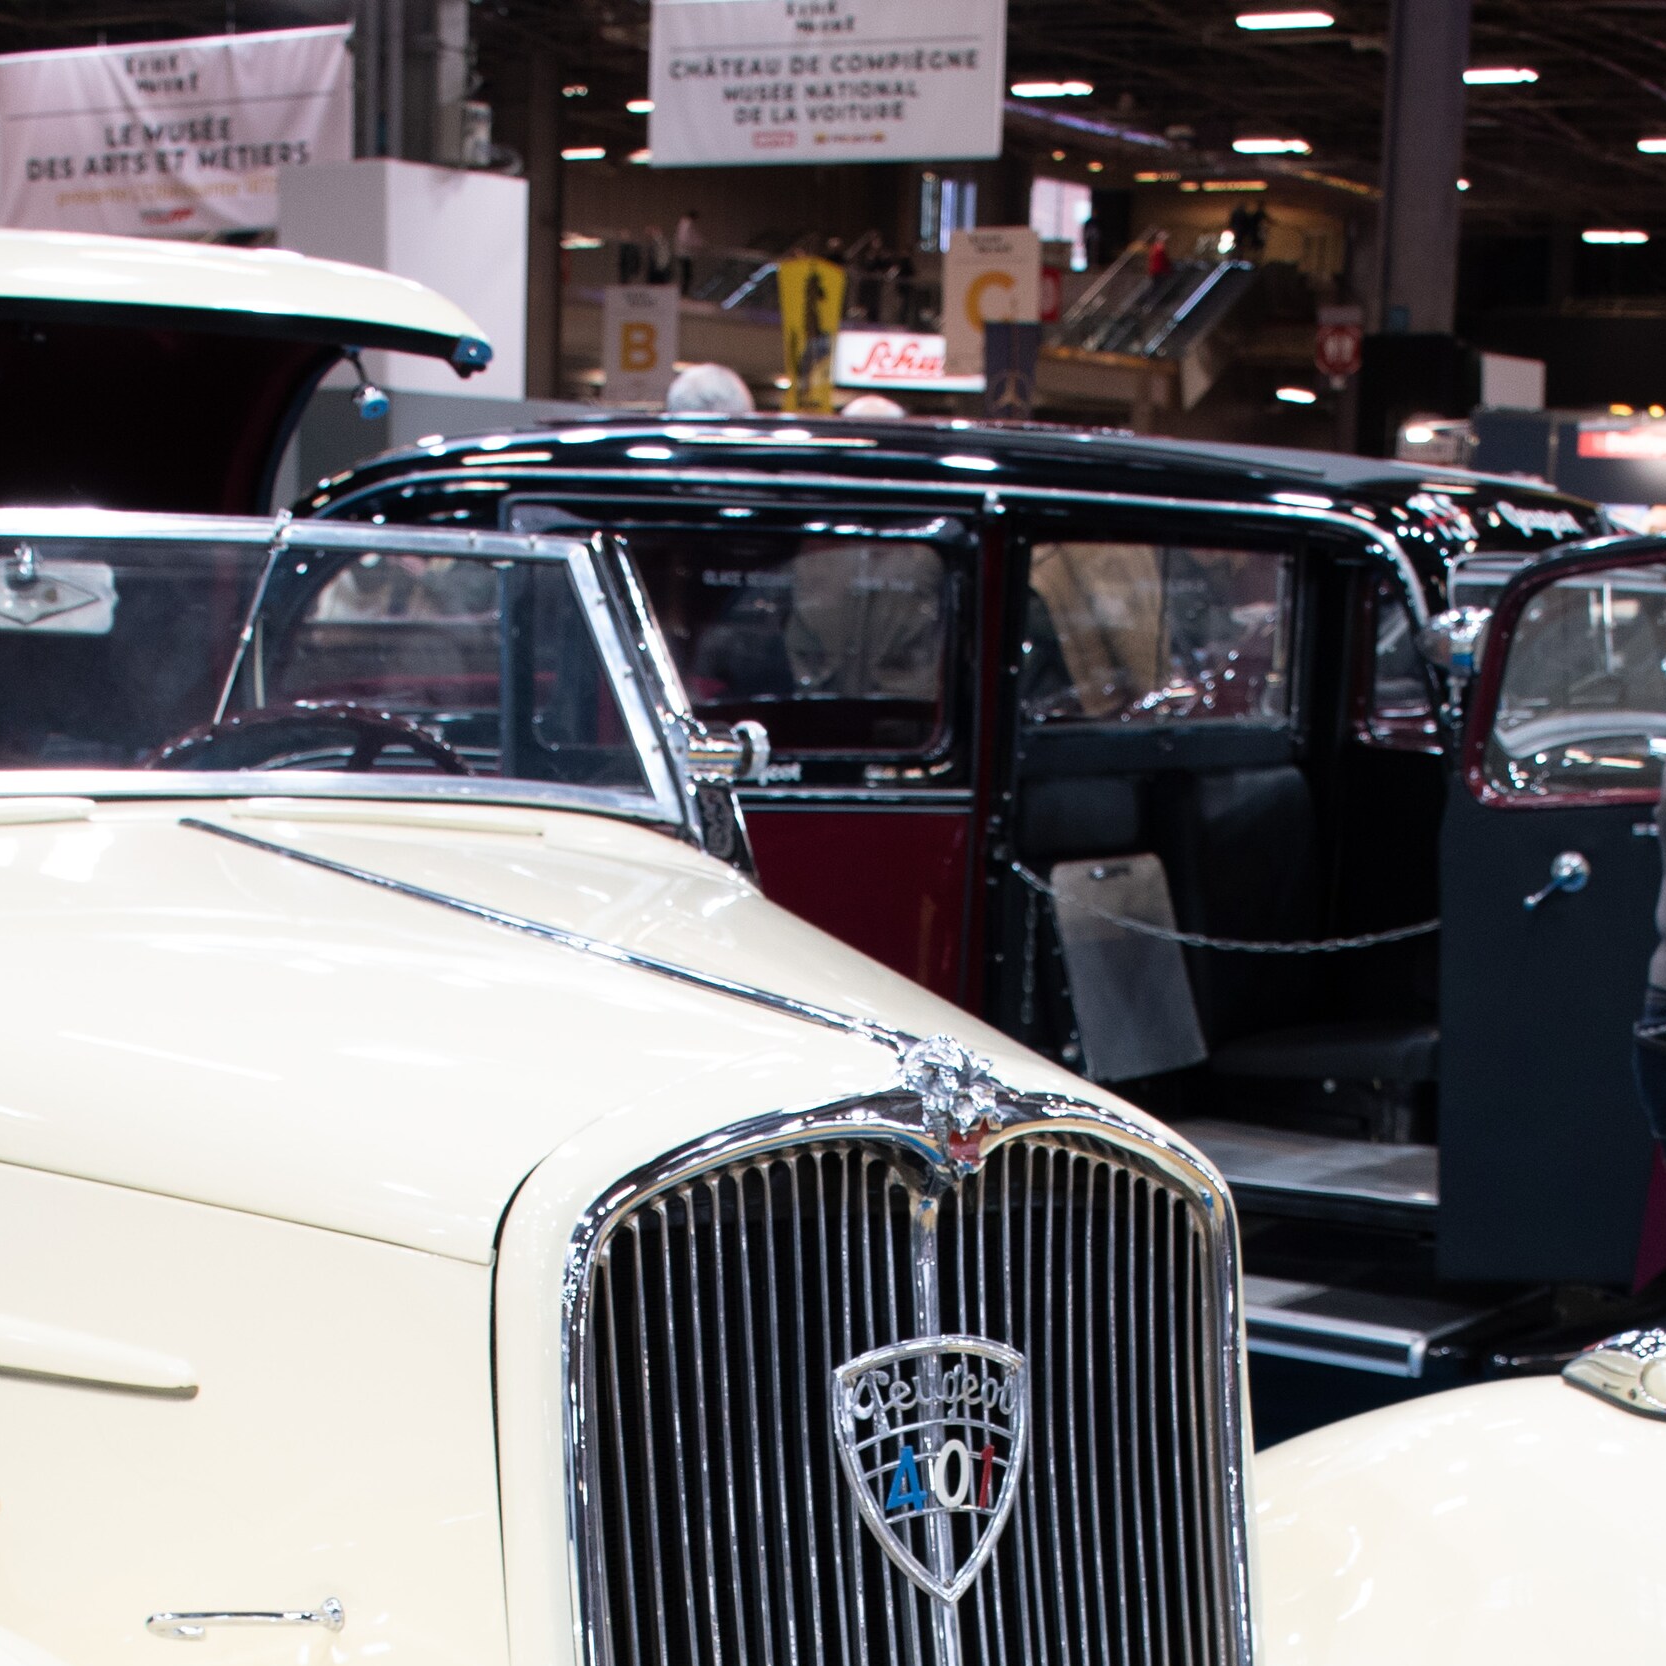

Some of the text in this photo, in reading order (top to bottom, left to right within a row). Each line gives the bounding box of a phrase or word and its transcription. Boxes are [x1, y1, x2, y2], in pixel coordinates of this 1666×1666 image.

[668, 47, 979, 80] CHÂTEAU DE COMPIÈGNE
[804, 79, 918, 101] NATIONAL
[734, 99, 906, 126] DE LA VOITURE
[25, 156, 74, 182] DES
[83, 150, 149, 176] ARTS
[155, 149, 184, 174] ET
[619, 322, 657, 372] B
[885, 1438, 996, 1512] 401
